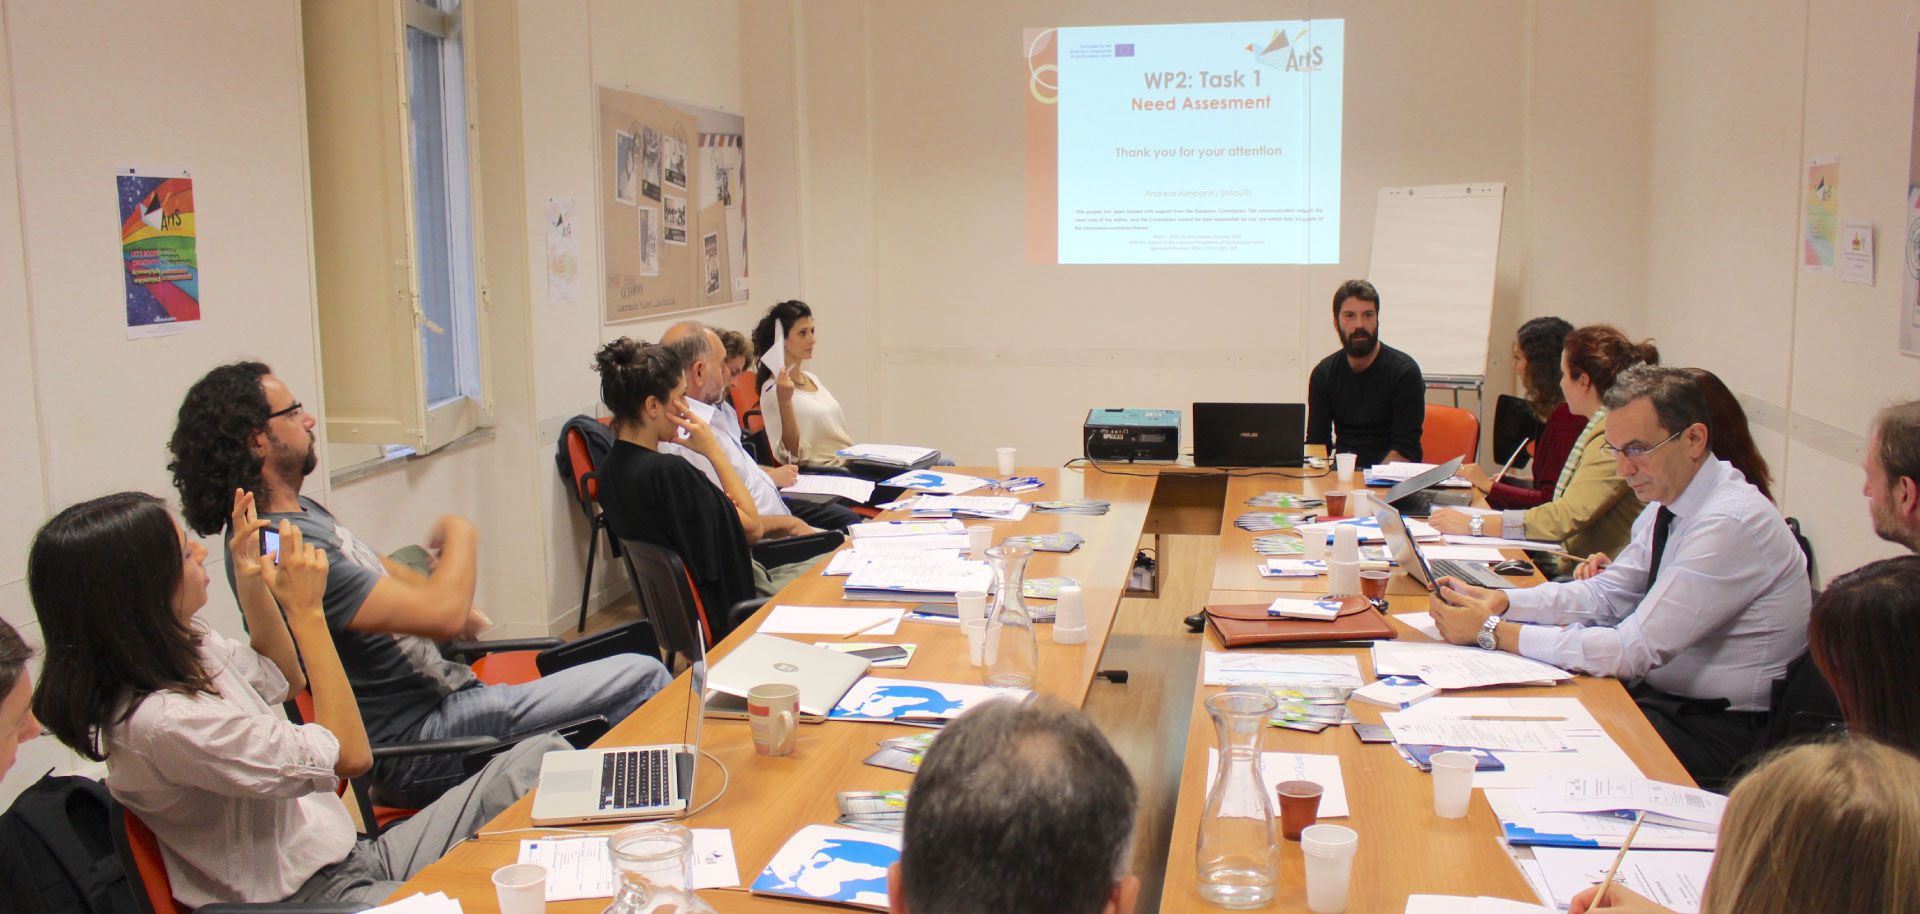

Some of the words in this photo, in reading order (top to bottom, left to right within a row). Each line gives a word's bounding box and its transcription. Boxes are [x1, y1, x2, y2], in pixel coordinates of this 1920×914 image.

[1285, 46, 1323, 72] ArtS
[1144, 71, 1193, 90] WP2:
[1199, 70, 1245, 88] Task
[1253, 69, 1260, 87] 1
[1131, 97, 1176, 111] Need
[1182, 95, 1271, 110] Assesment
[1115, 147, 1150, 158] Thank
[1154, 149, 1176, 159] you
[1179, 147, 1195, 157] for
[1199, 148, 1225, 159] your
[1228, 146, 1282, 157] attention
[1144, 190, 1177, 198] Andreas
[161, 209, 181, 231] ArtS
